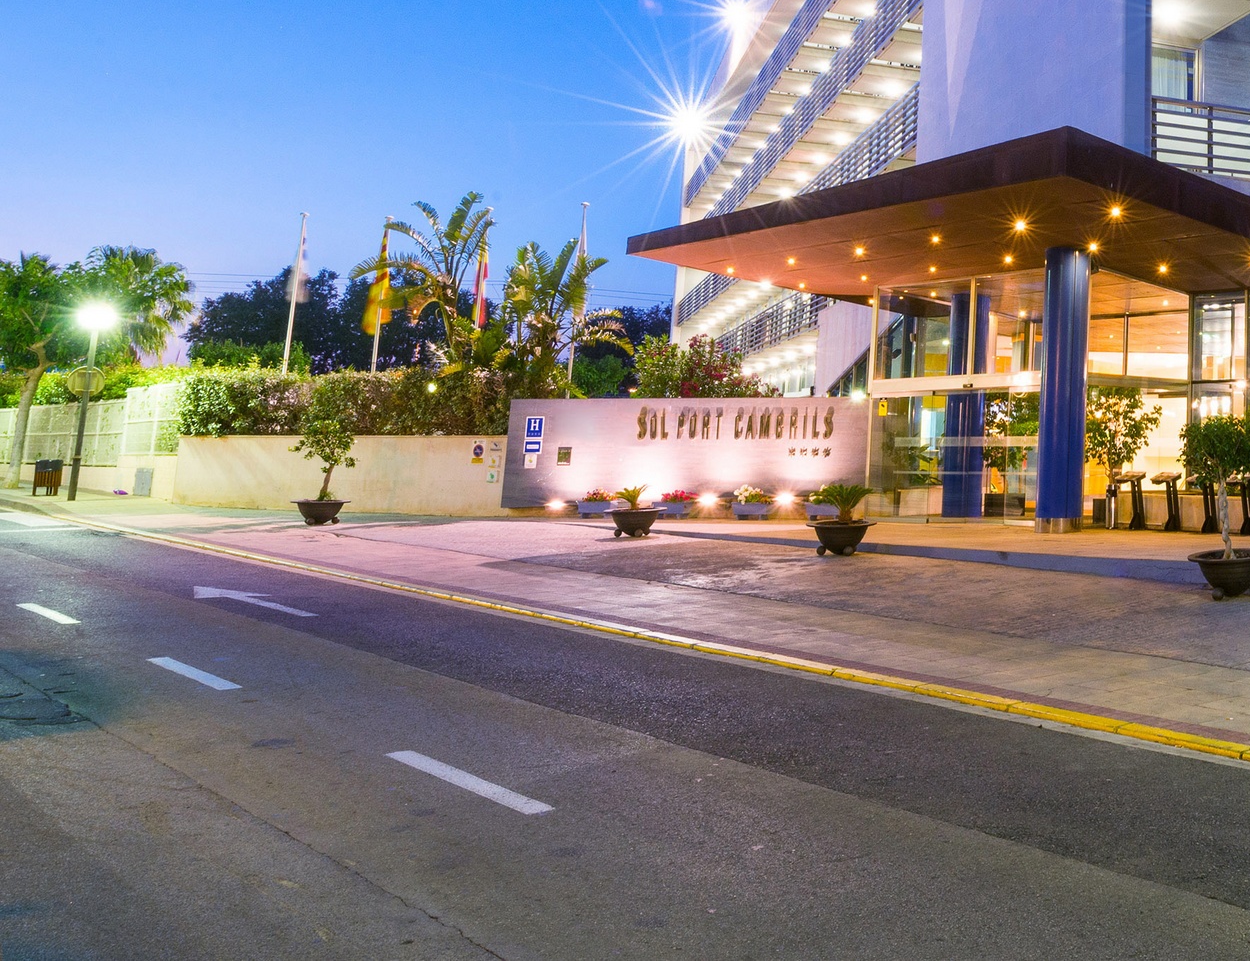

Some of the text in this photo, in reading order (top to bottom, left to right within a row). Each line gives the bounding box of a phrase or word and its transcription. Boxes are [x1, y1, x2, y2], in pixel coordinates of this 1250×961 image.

[530, 419, 540, 431] H
[637, 408, 834, 440] SOL PORT CAMBRILS
